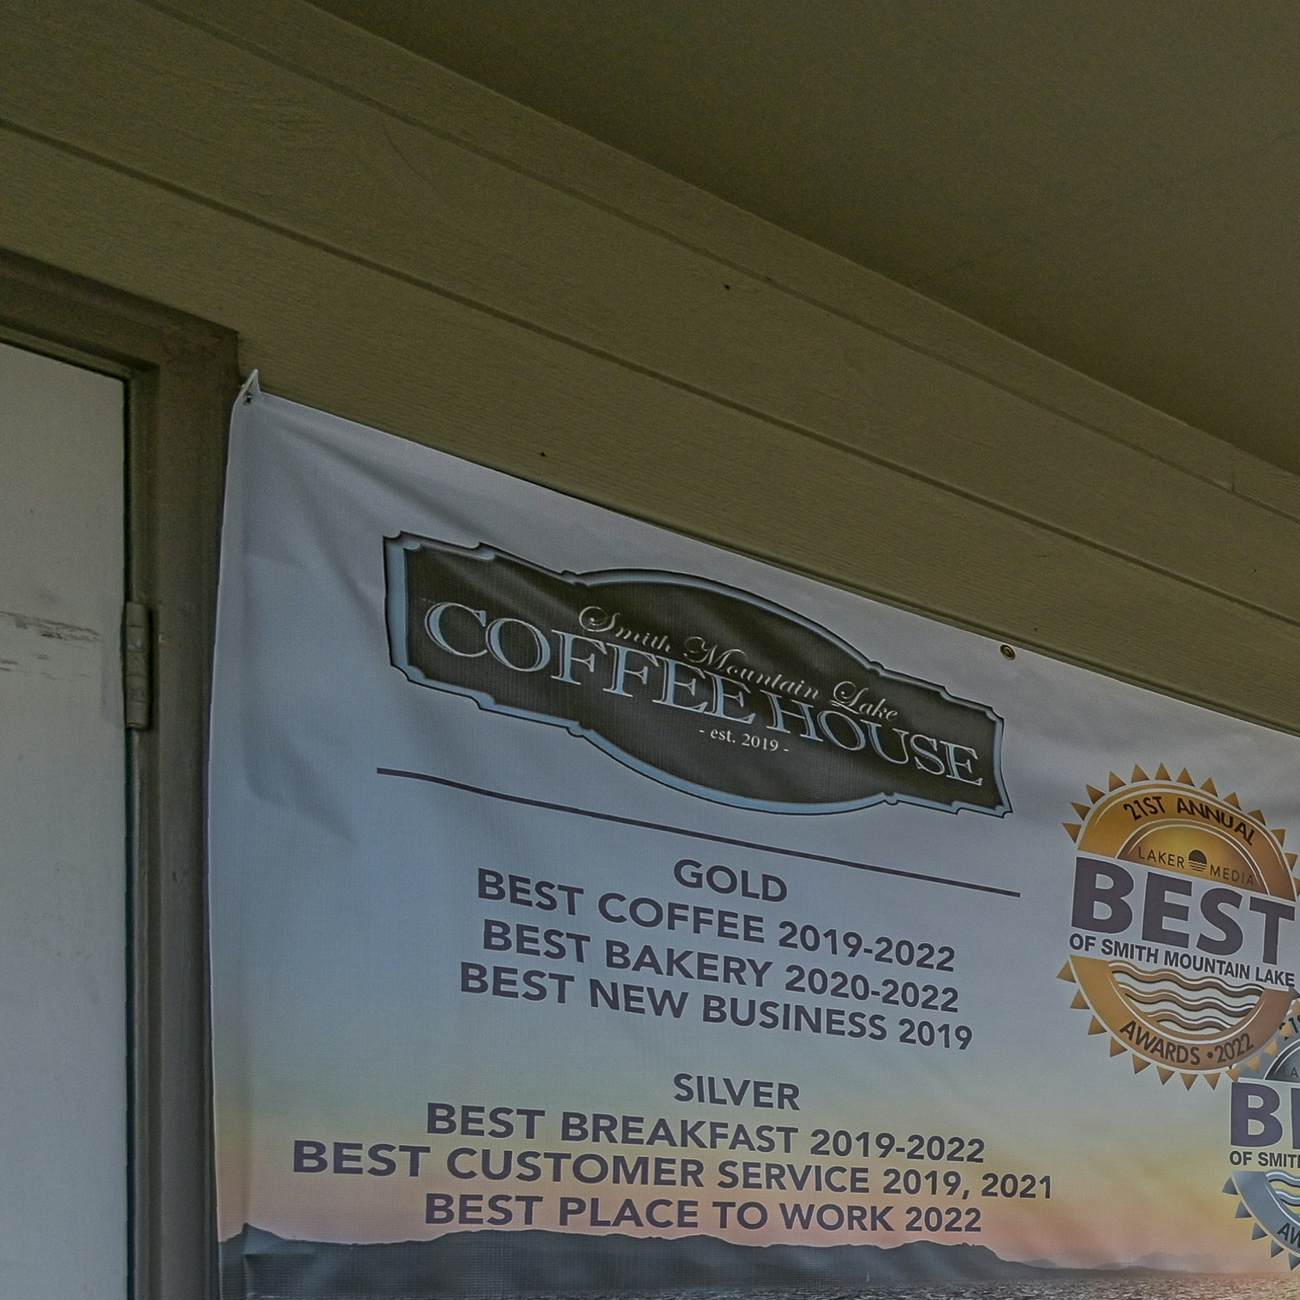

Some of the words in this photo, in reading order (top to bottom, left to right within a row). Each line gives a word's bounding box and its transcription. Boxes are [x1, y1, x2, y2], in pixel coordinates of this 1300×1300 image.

[578, 606, 671, 653] Smith
[683, 636, 820, 700] Mountain
[829, 680, 900, 722] Lake
[424, 602, 754, 725] COFFEE
[760, 689, 983, 786] HOUSE
[710, 727, 736, 744] est.
[741, 733, 779, 752] 2019
[1123, 796, 1166, 821] 21ST
[1177, 798, 1255, 846] ANNUAL
[673, 859, 788, 902] GOLD
[1137, 847, 1185, 869] LAKER
[1210, 864, 1255, 886] MEDIA
[478, 867, 584, 916] BEST
[598, 892, 765, 943] COFFEE
[778, 920, 955, 972] 2019-2022
[1071, 856, 1296, 966] BEST
[483, 919, 591, 963] BEST
[606, 939, 773, 987] BAKERY
[785, 965, 959, 1013] 2020-2022
[1069, 933, 1097, 952] OF
[1101, 938, 1158, 964] SMITH
[1164, 951, 1250, 980] MOUNTAIN
[1255, 968, 1296, 988] LAKE
[460, 961, 575, 1004] BEST
[589, 978, 689, 1019] NEW
[703, 994, 887, 1041] BUSINESS
[898, 1018, 973, 1050] 2019
[1119, 1021, 1201, 1065] AWARDS
[1214, 1033, 1255, 1064] 2022
[674, 1073, 800, 1111] SILVER
[427, 1102, 545, 1139] BEST
[561, 1111, 798, 1153] BREAKFAST
[810, 1129, 984, 1163] 2019-2022
[1229, 1151, 1252, 1166] OF
[293, 1140, 431, 1177] BEST
[447, 1147, 704, 1188] CUSTOMER
[718, 1160, 869, 1193] SERVICE
[882, 1168, 970, 1199] 2019,
[981, 1172, 1051, 1199] 2021
[425, 1193, 543, 1225] BEST
[559, 1197, 698, 1228] PLACE
[712, 1201, 768, 1230] TO
[779, 1202, 895, 1232] WORK
[905, 1207, 981, 1232] 2022
